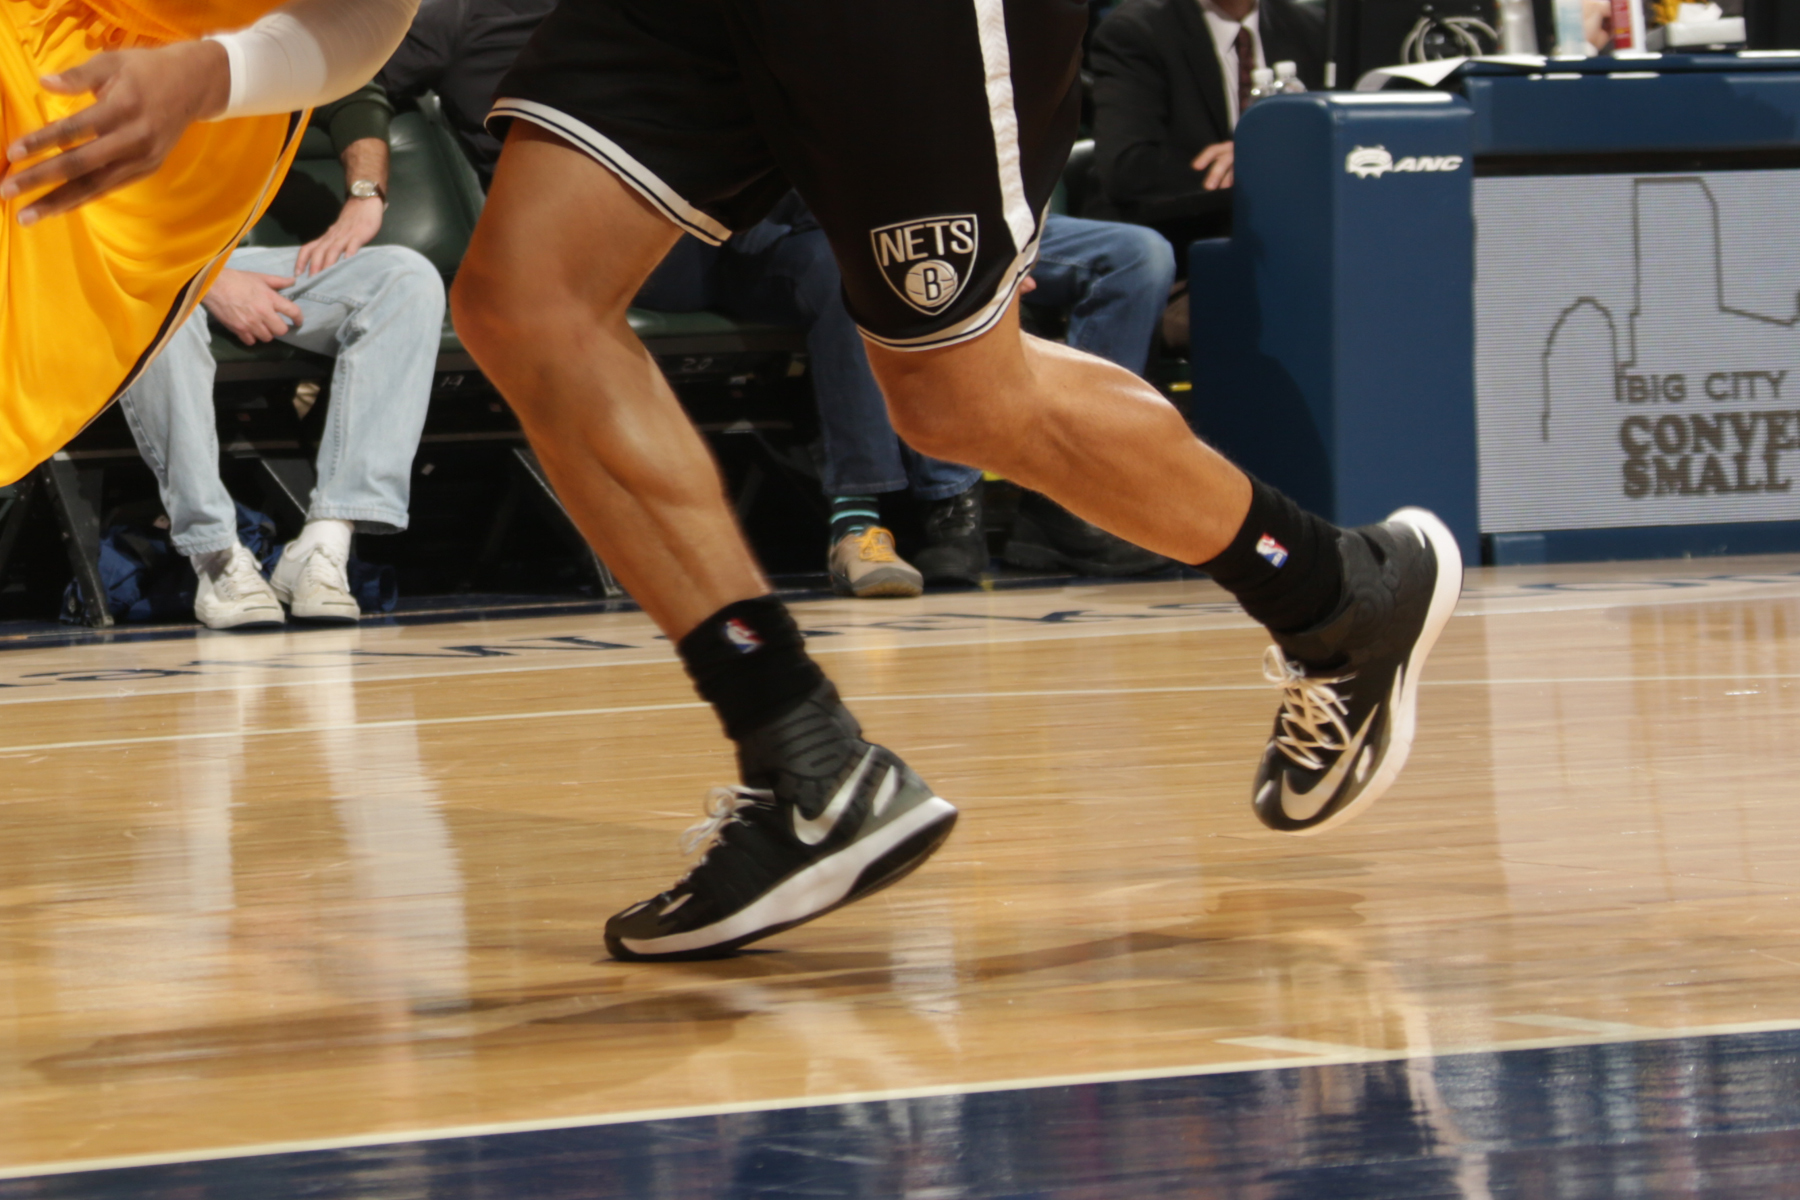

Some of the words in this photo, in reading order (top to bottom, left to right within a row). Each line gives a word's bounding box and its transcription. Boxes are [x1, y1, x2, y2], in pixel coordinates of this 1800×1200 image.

[1394, 154, 1463, 174] ANC
[879, 219, 975, 268] NETS
[922, 267, 942, 302] B
[1626, 373, 1687, 403] BIG
[1704, 369, 1789, 401] CITY
[1622, 450, 1792, 498] SMALL
